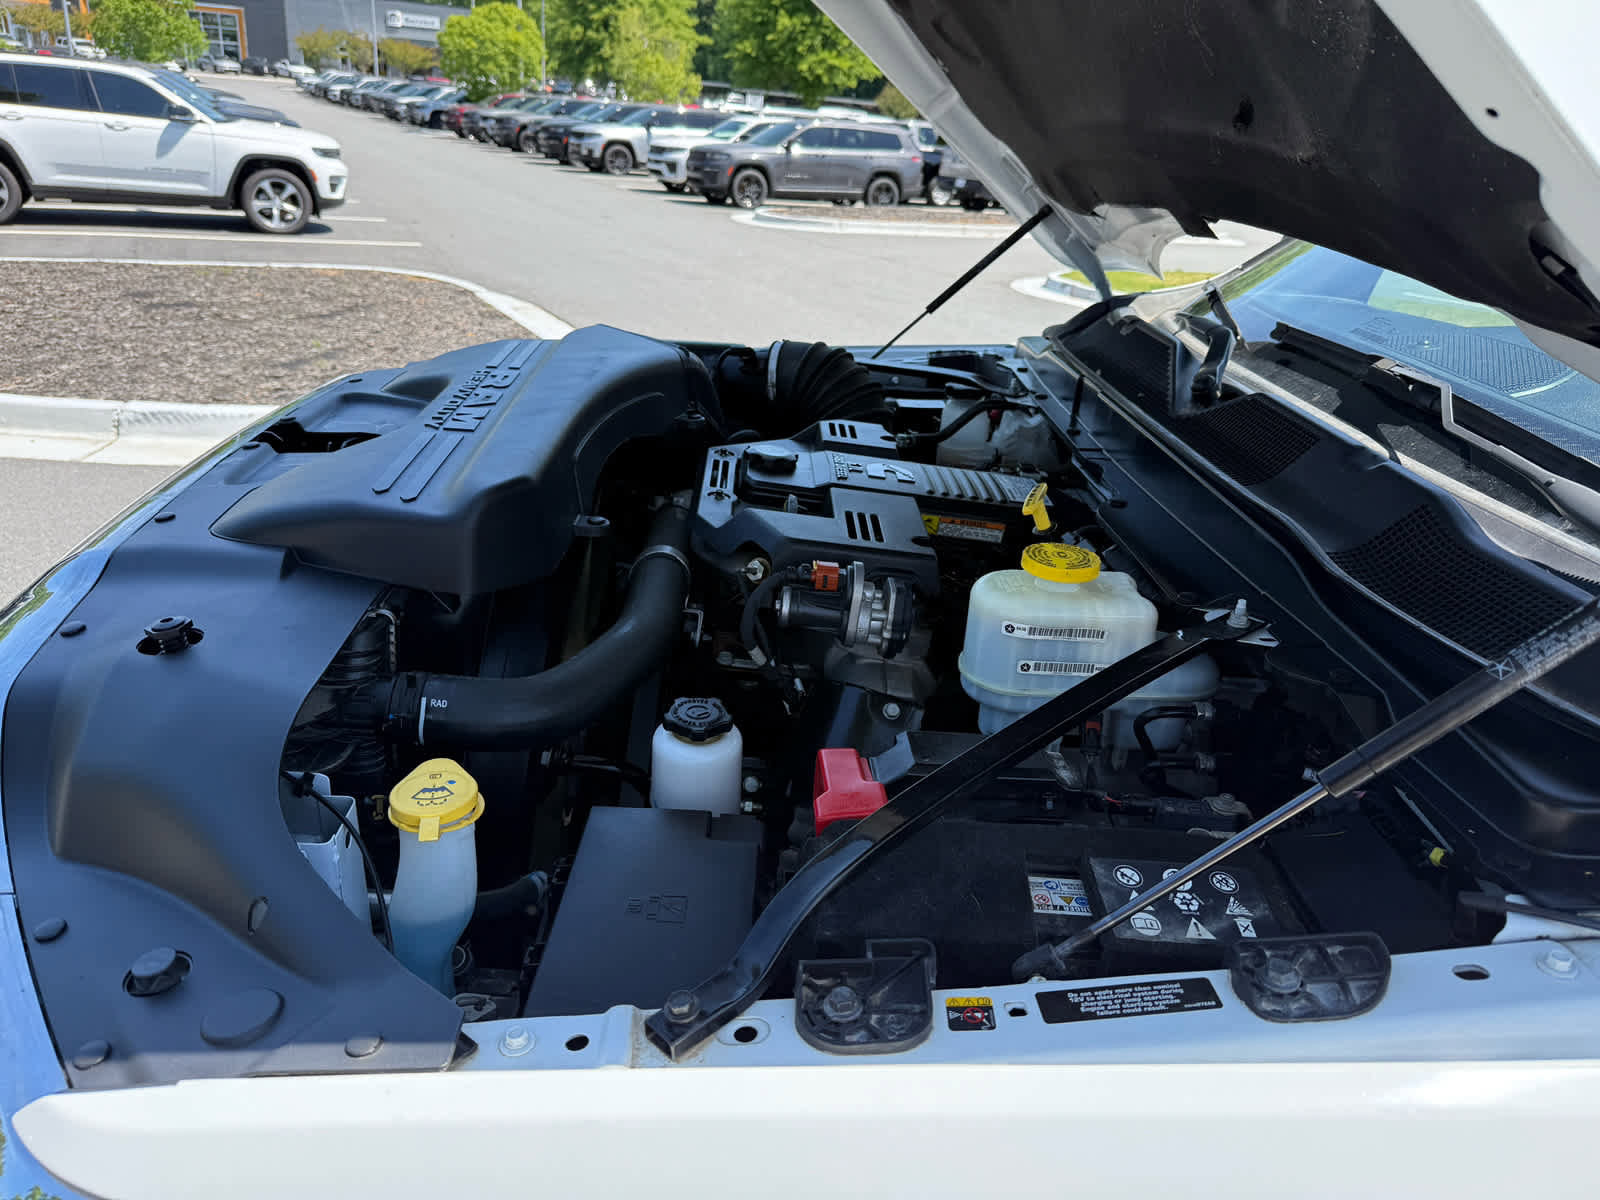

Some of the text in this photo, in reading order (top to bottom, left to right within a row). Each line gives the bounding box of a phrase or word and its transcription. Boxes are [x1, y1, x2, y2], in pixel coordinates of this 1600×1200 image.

[443, 368, 521, 432] RAM
[430, 698, 448, 708] RAD
[1160, 987, 1184, 995] during
[1121, 1000, 1153, 1008] starting
[1154, 998, 1181, 1006] system
